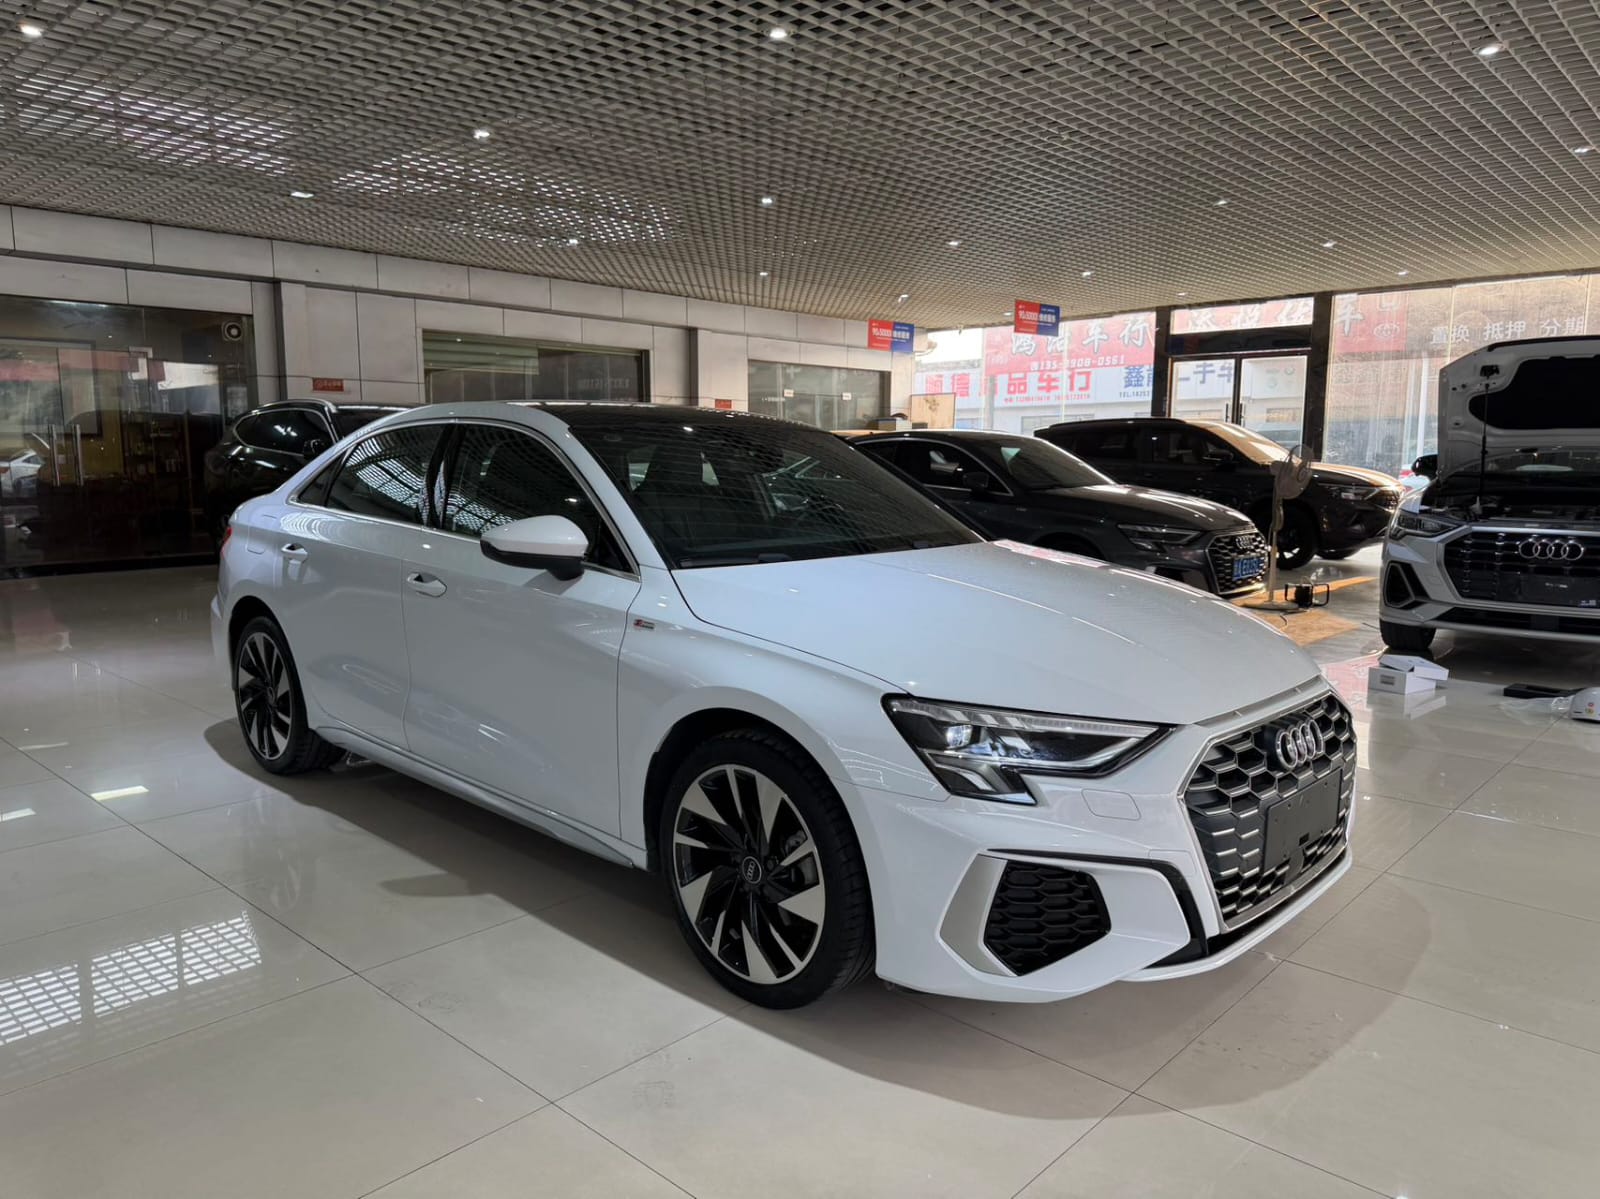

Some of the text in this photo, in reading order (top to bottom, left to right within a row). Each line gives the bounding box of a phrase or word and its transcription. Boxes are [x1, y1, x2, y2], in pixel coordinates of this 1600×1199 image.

[1430, 316, 1584, 345] 置换 抵押 分期
[925, 370, 1092, 397] 顺信品车行
